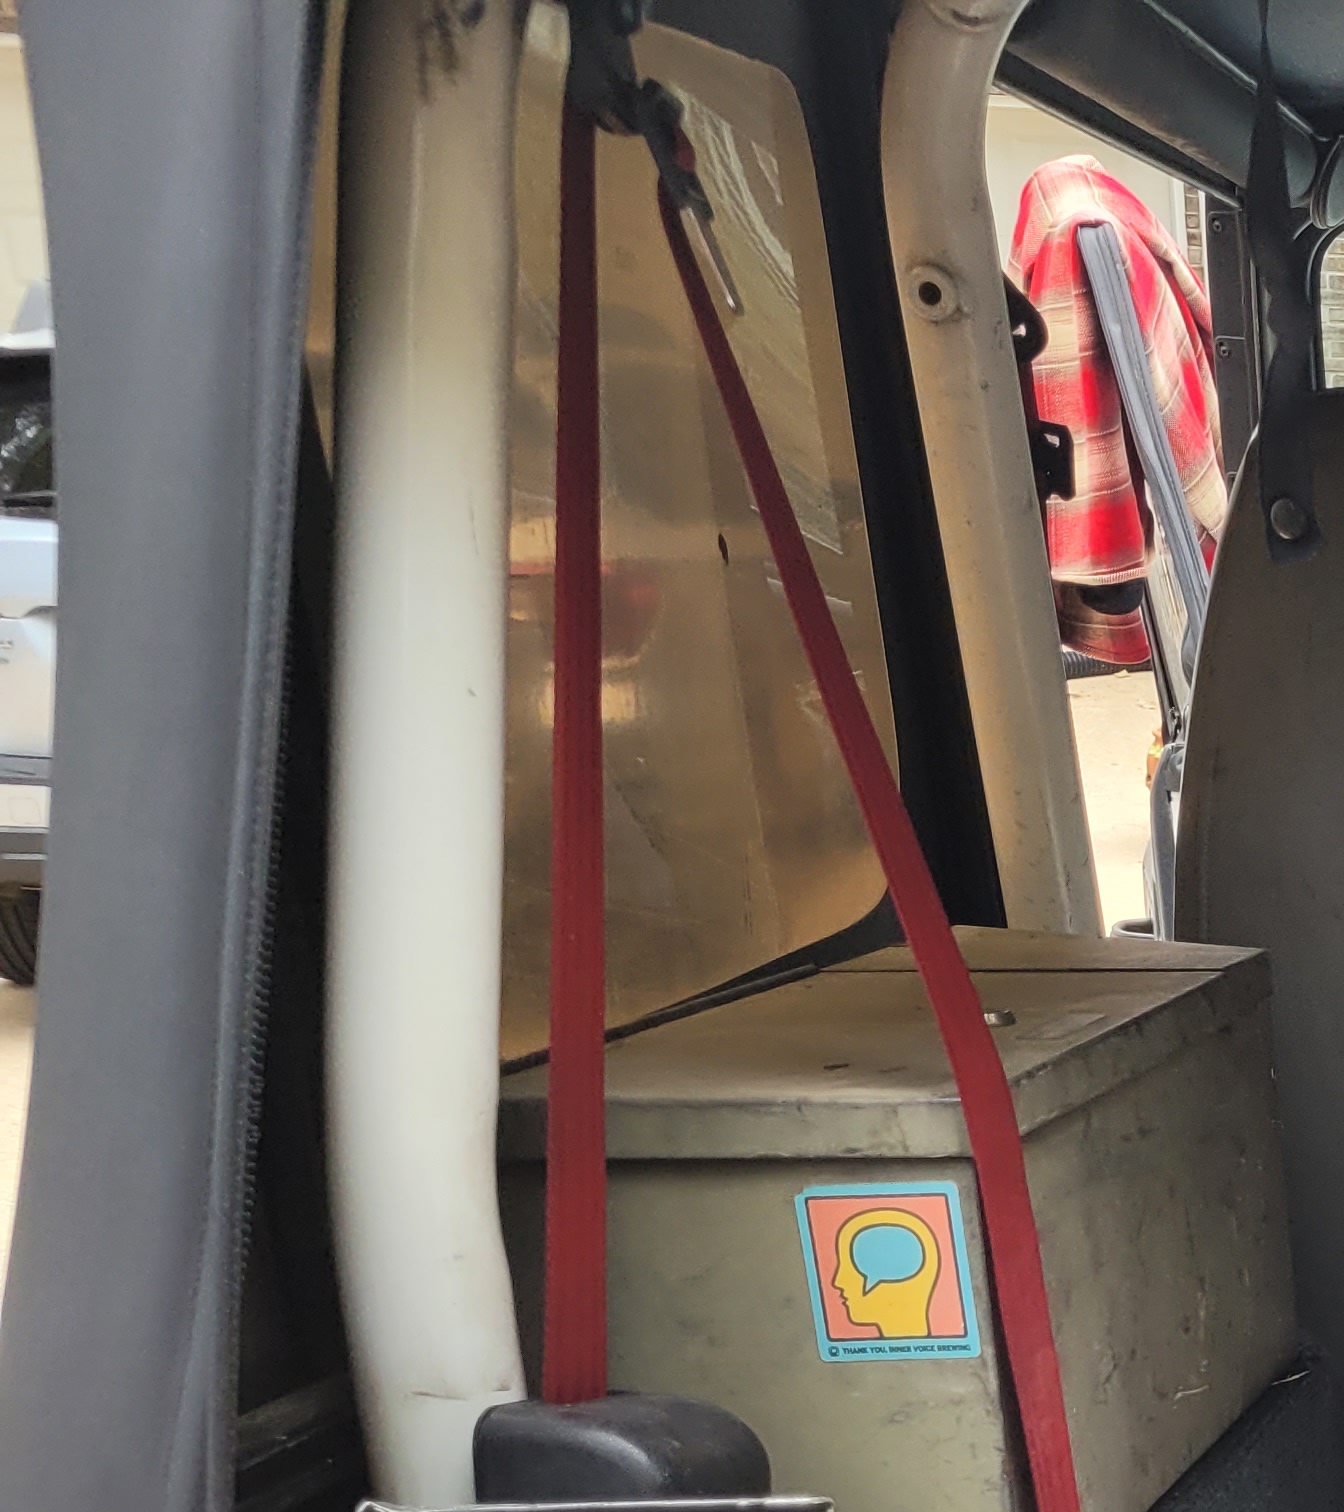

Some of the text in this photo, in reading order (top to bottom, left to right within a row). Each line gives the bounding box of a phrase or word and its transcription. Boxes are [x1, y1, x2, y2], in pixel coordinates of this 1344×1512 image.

[842, 1346, 868, 1355] THANK
[889, 1345, 912, 1353] INNER
[913, 1344, 936, 1353] VOICE
[937, 1343, 971, 1352] BREWING
